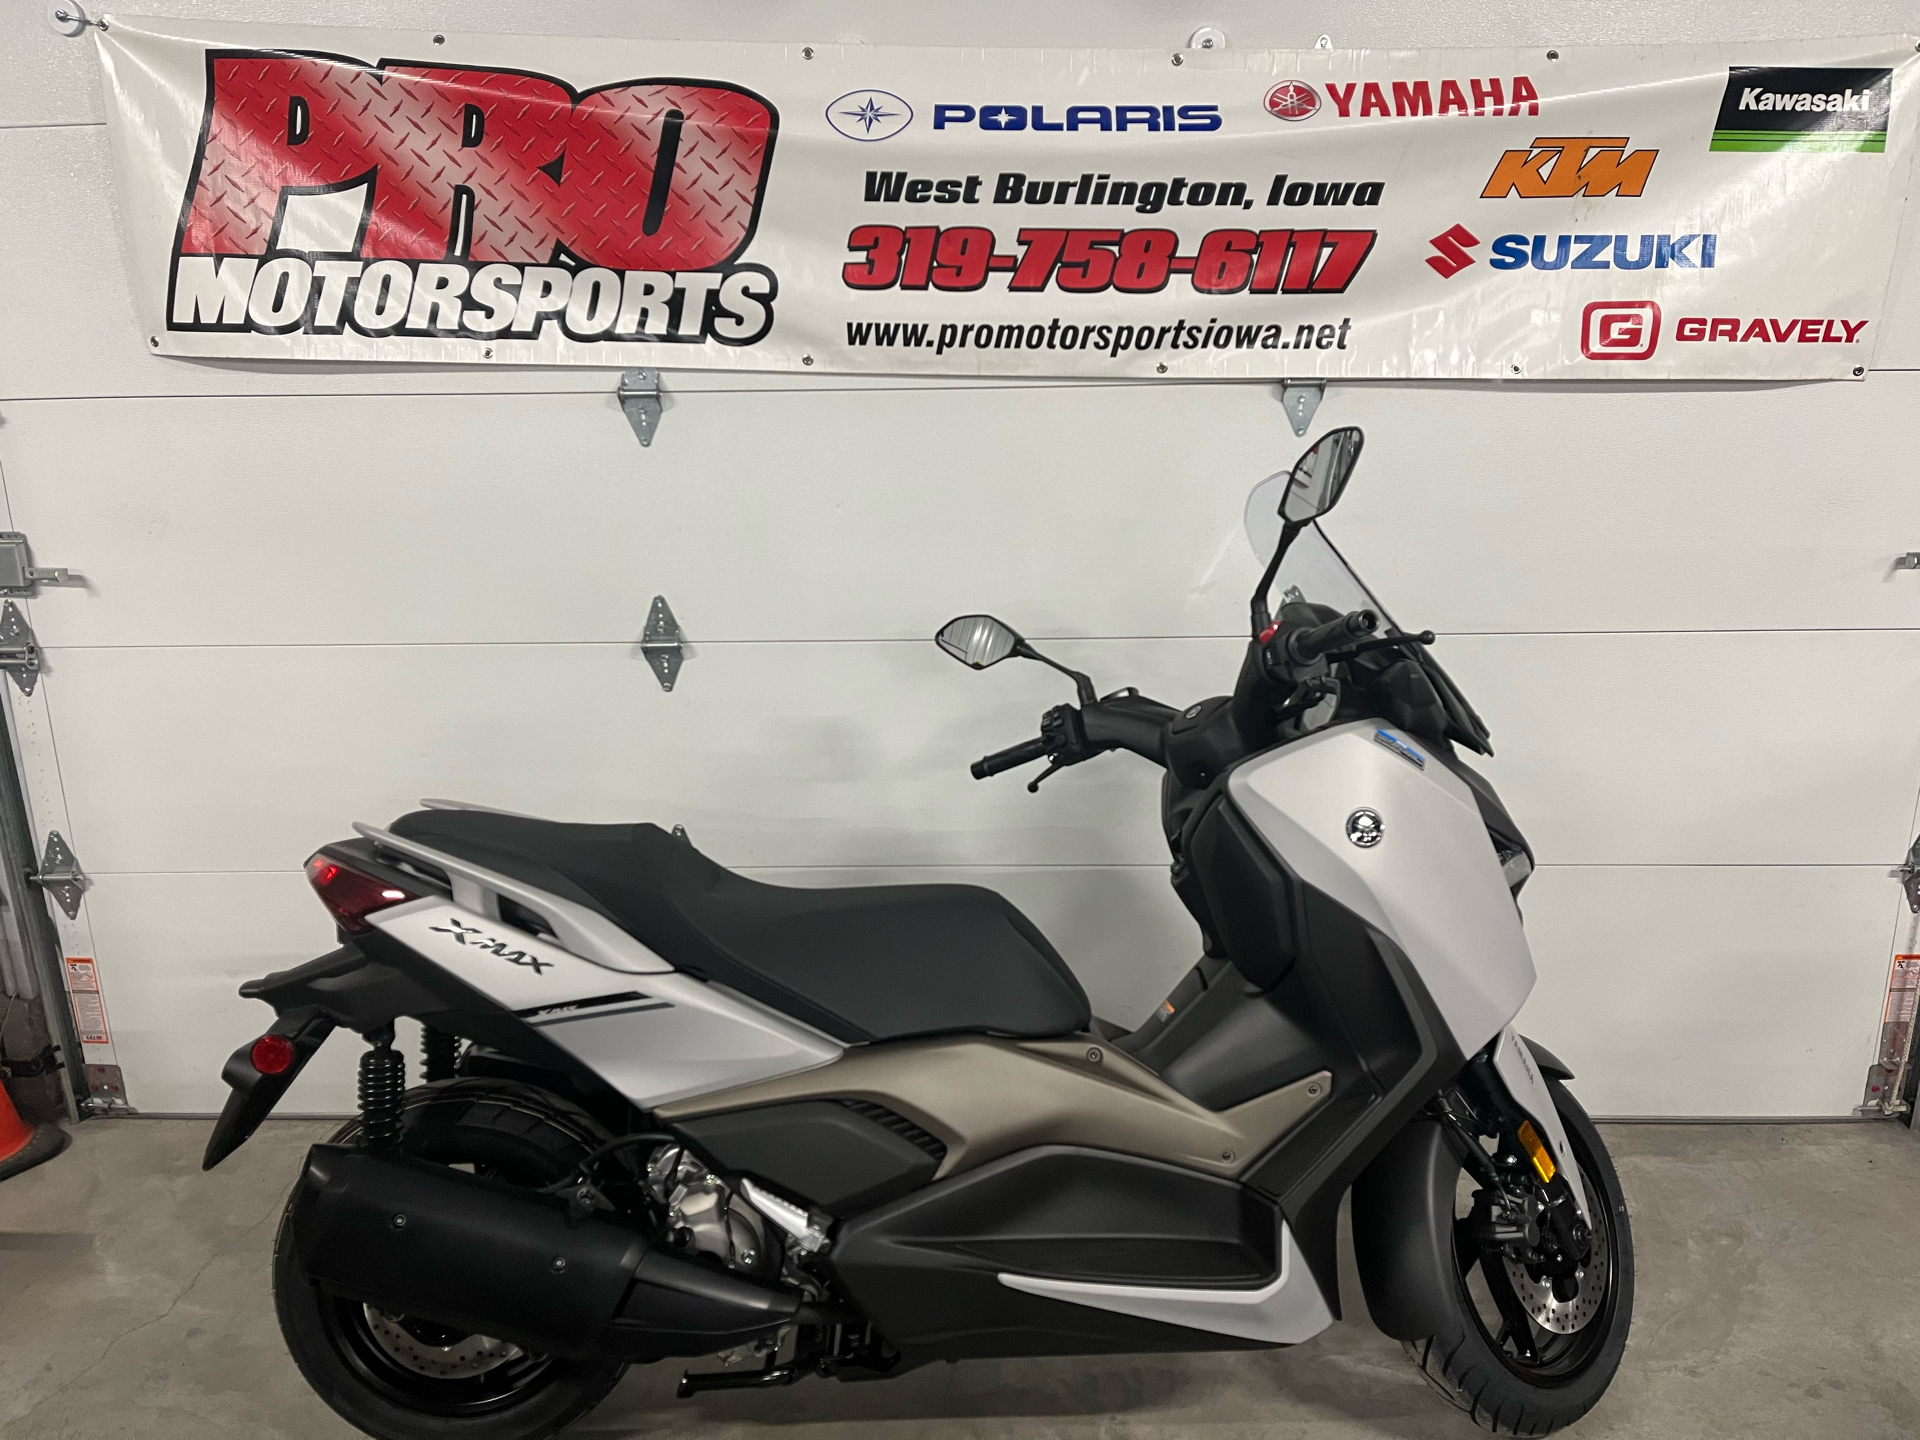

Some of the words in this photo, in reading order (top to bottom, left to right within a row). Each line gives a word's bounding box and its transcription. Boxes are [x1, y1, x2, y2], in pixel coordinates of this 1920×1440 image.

[933, 104, 1223, 132] POLARIS
[1325, 76, 1539, 118] YAMAHA
[1738, 87, 1870, 112] Kawasaki
[174, 48, 779, 271] PRO
[1480, 136, 1659, 198] KTM
[864, 171, 983, 204] West
[993, 172, 1254, 213] Burlington,
[1266, 174, 1385, 206] Iowa
[842, 225, 1377, 294] 319-758-6117
[1489, 233, 1717, 270] SUZUKI
[167, 256, 777, 346] MOTORSPORTS
[846, 317, 1351, 357] www.promotorsportsiowa.net
[1675, 317, 1869, 344] GRAVELY
